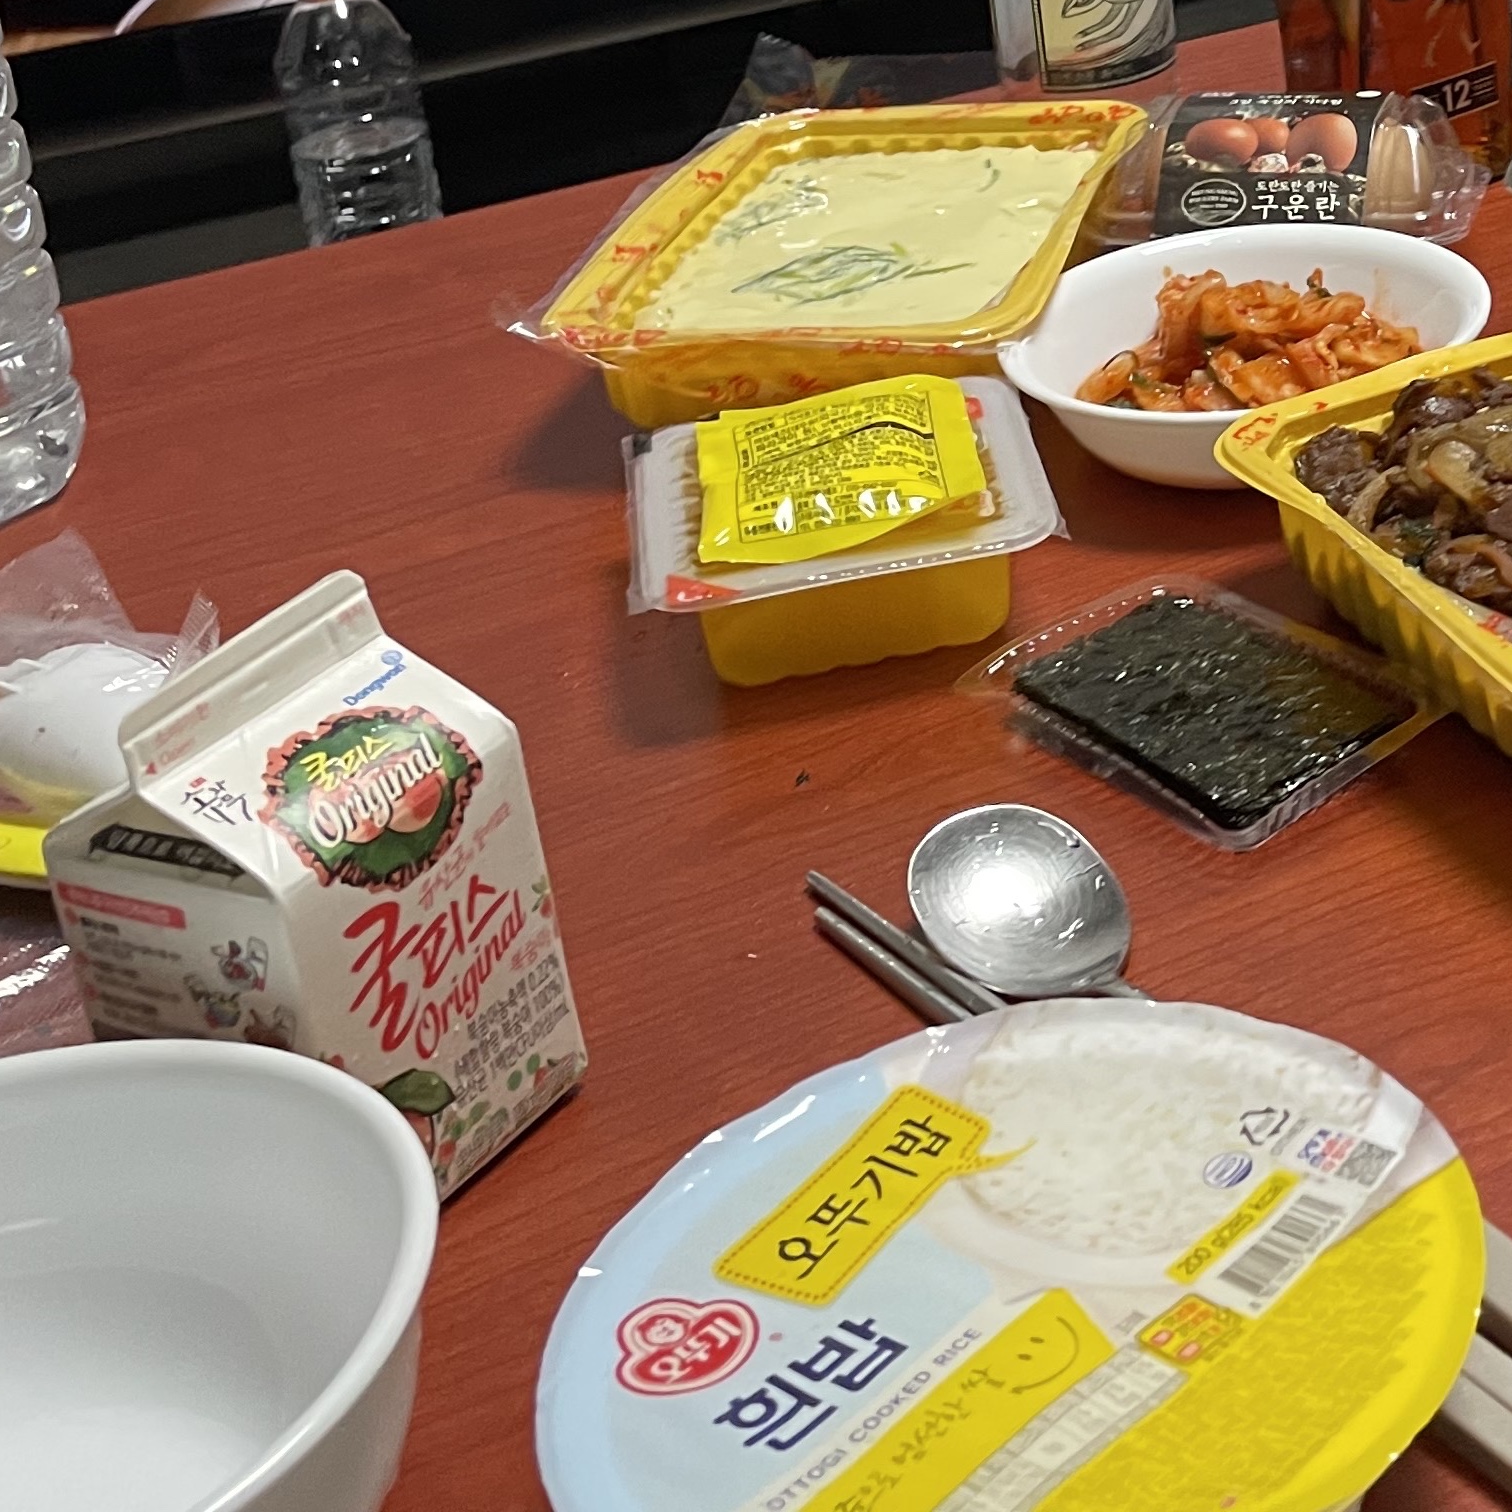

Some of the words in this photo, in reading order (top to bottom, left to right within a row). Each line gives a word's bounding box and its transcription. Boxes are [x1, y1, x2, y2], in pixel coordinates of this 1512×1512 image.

[1442, 78, 1472, 112] 12
[1251, 193, 1341, 220] 구운란
[309, 732, 443, 849] Original
[343, 874, 510, 1053] 쿨피스
[415, 888, 526, 1060] Original
[776, 1114, 952, 1281] 오뚜기밥
[650, 1316, 742, 1384] 오뚜기
[712, 1317, 909, 1452] 흰밥
[766, 1447, 848, 1511] OTTOGI
[849, 1370, 931, 1443] COOKED
[932, 1326, 983, 1367] RICE
